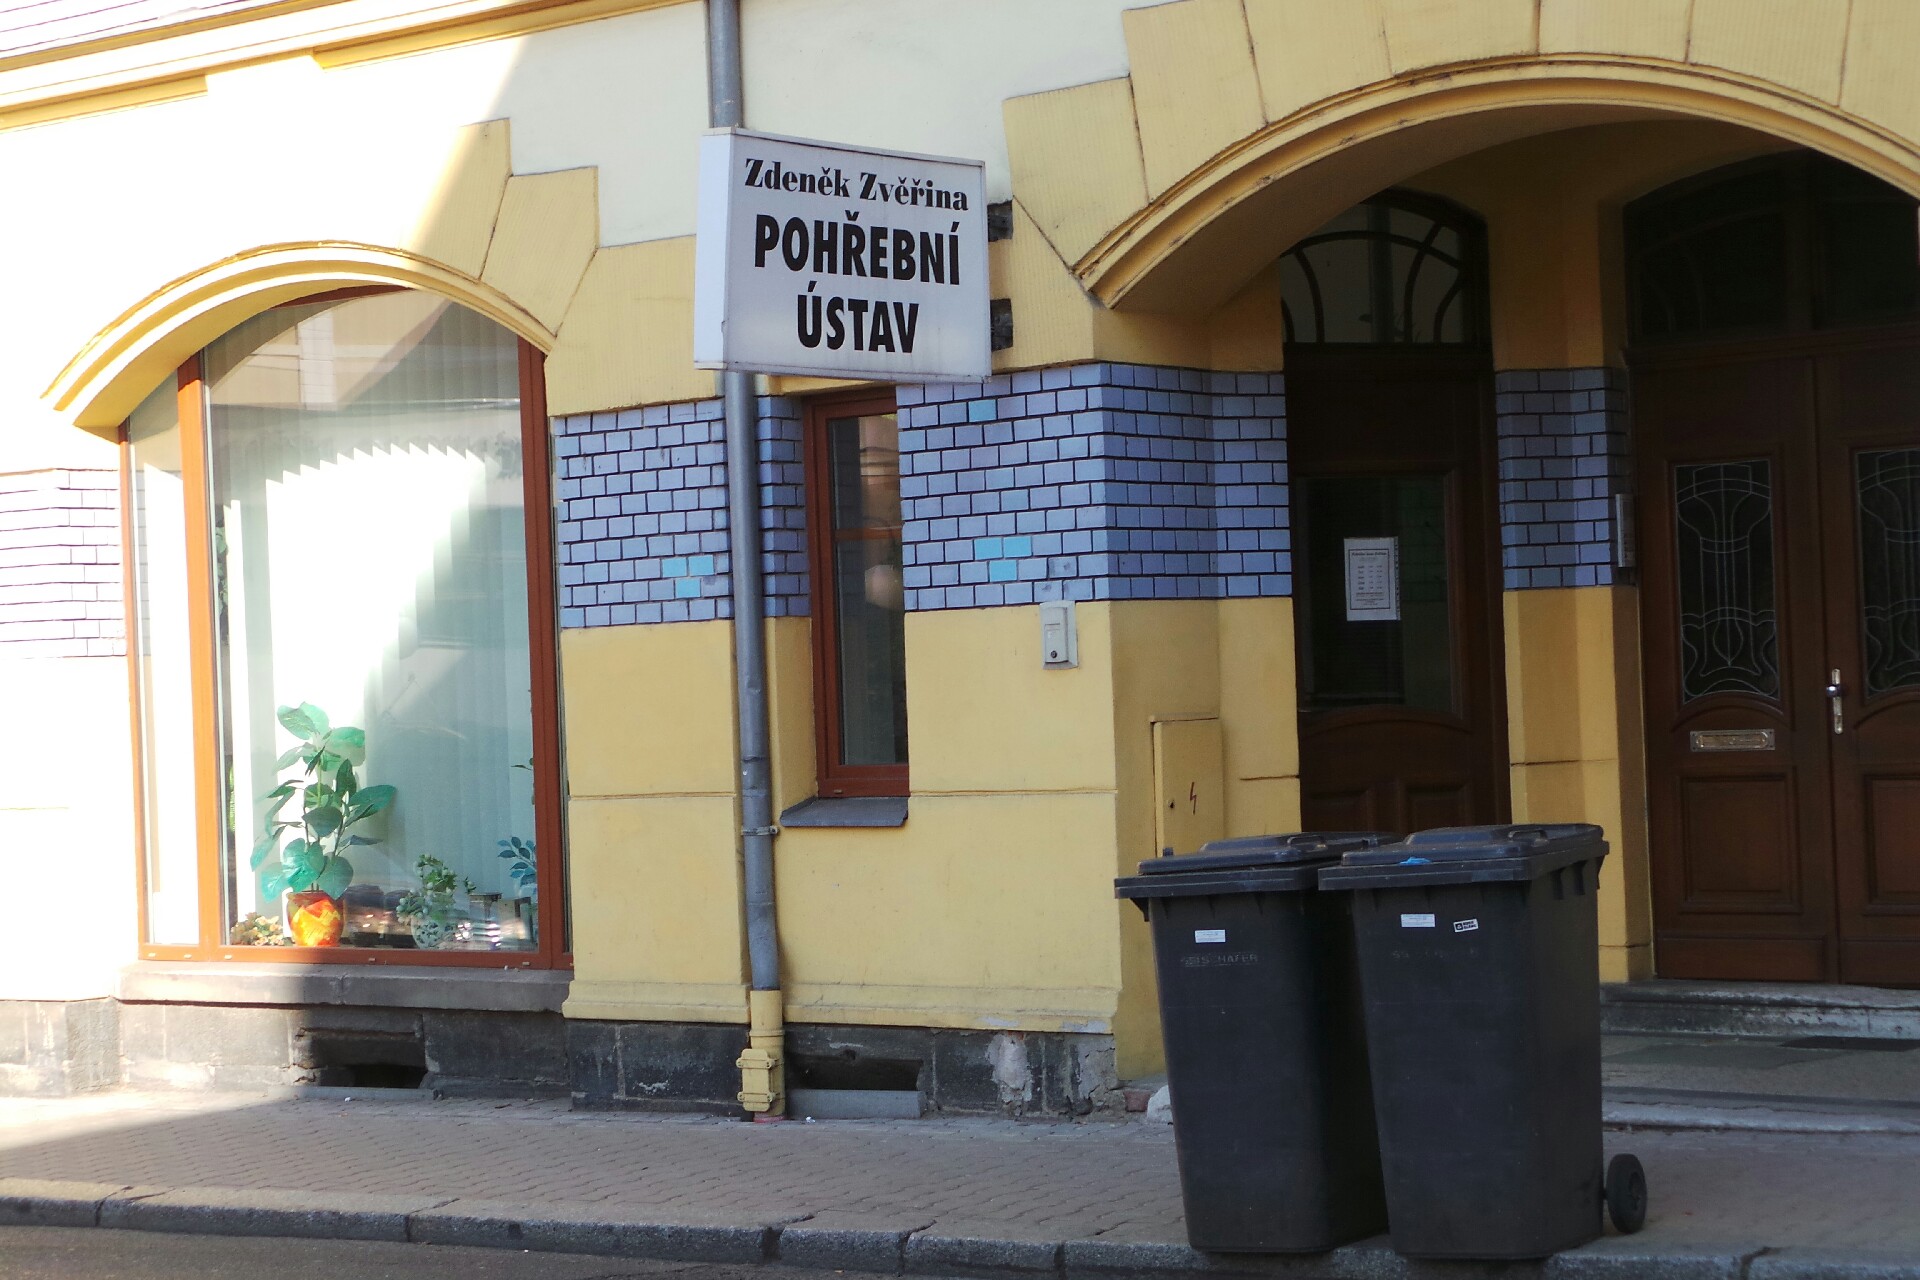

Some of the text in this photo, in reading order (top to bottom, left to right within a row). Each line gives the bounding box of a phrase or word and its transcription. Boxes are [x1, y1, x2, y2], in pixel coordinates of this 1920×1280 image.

[744, 158, 969, 211] Zdeněk Zvěřina
[754, 209, 960, 286] POHŘEBNÍ
[796, 280, 920, 354] ÚSTAV
